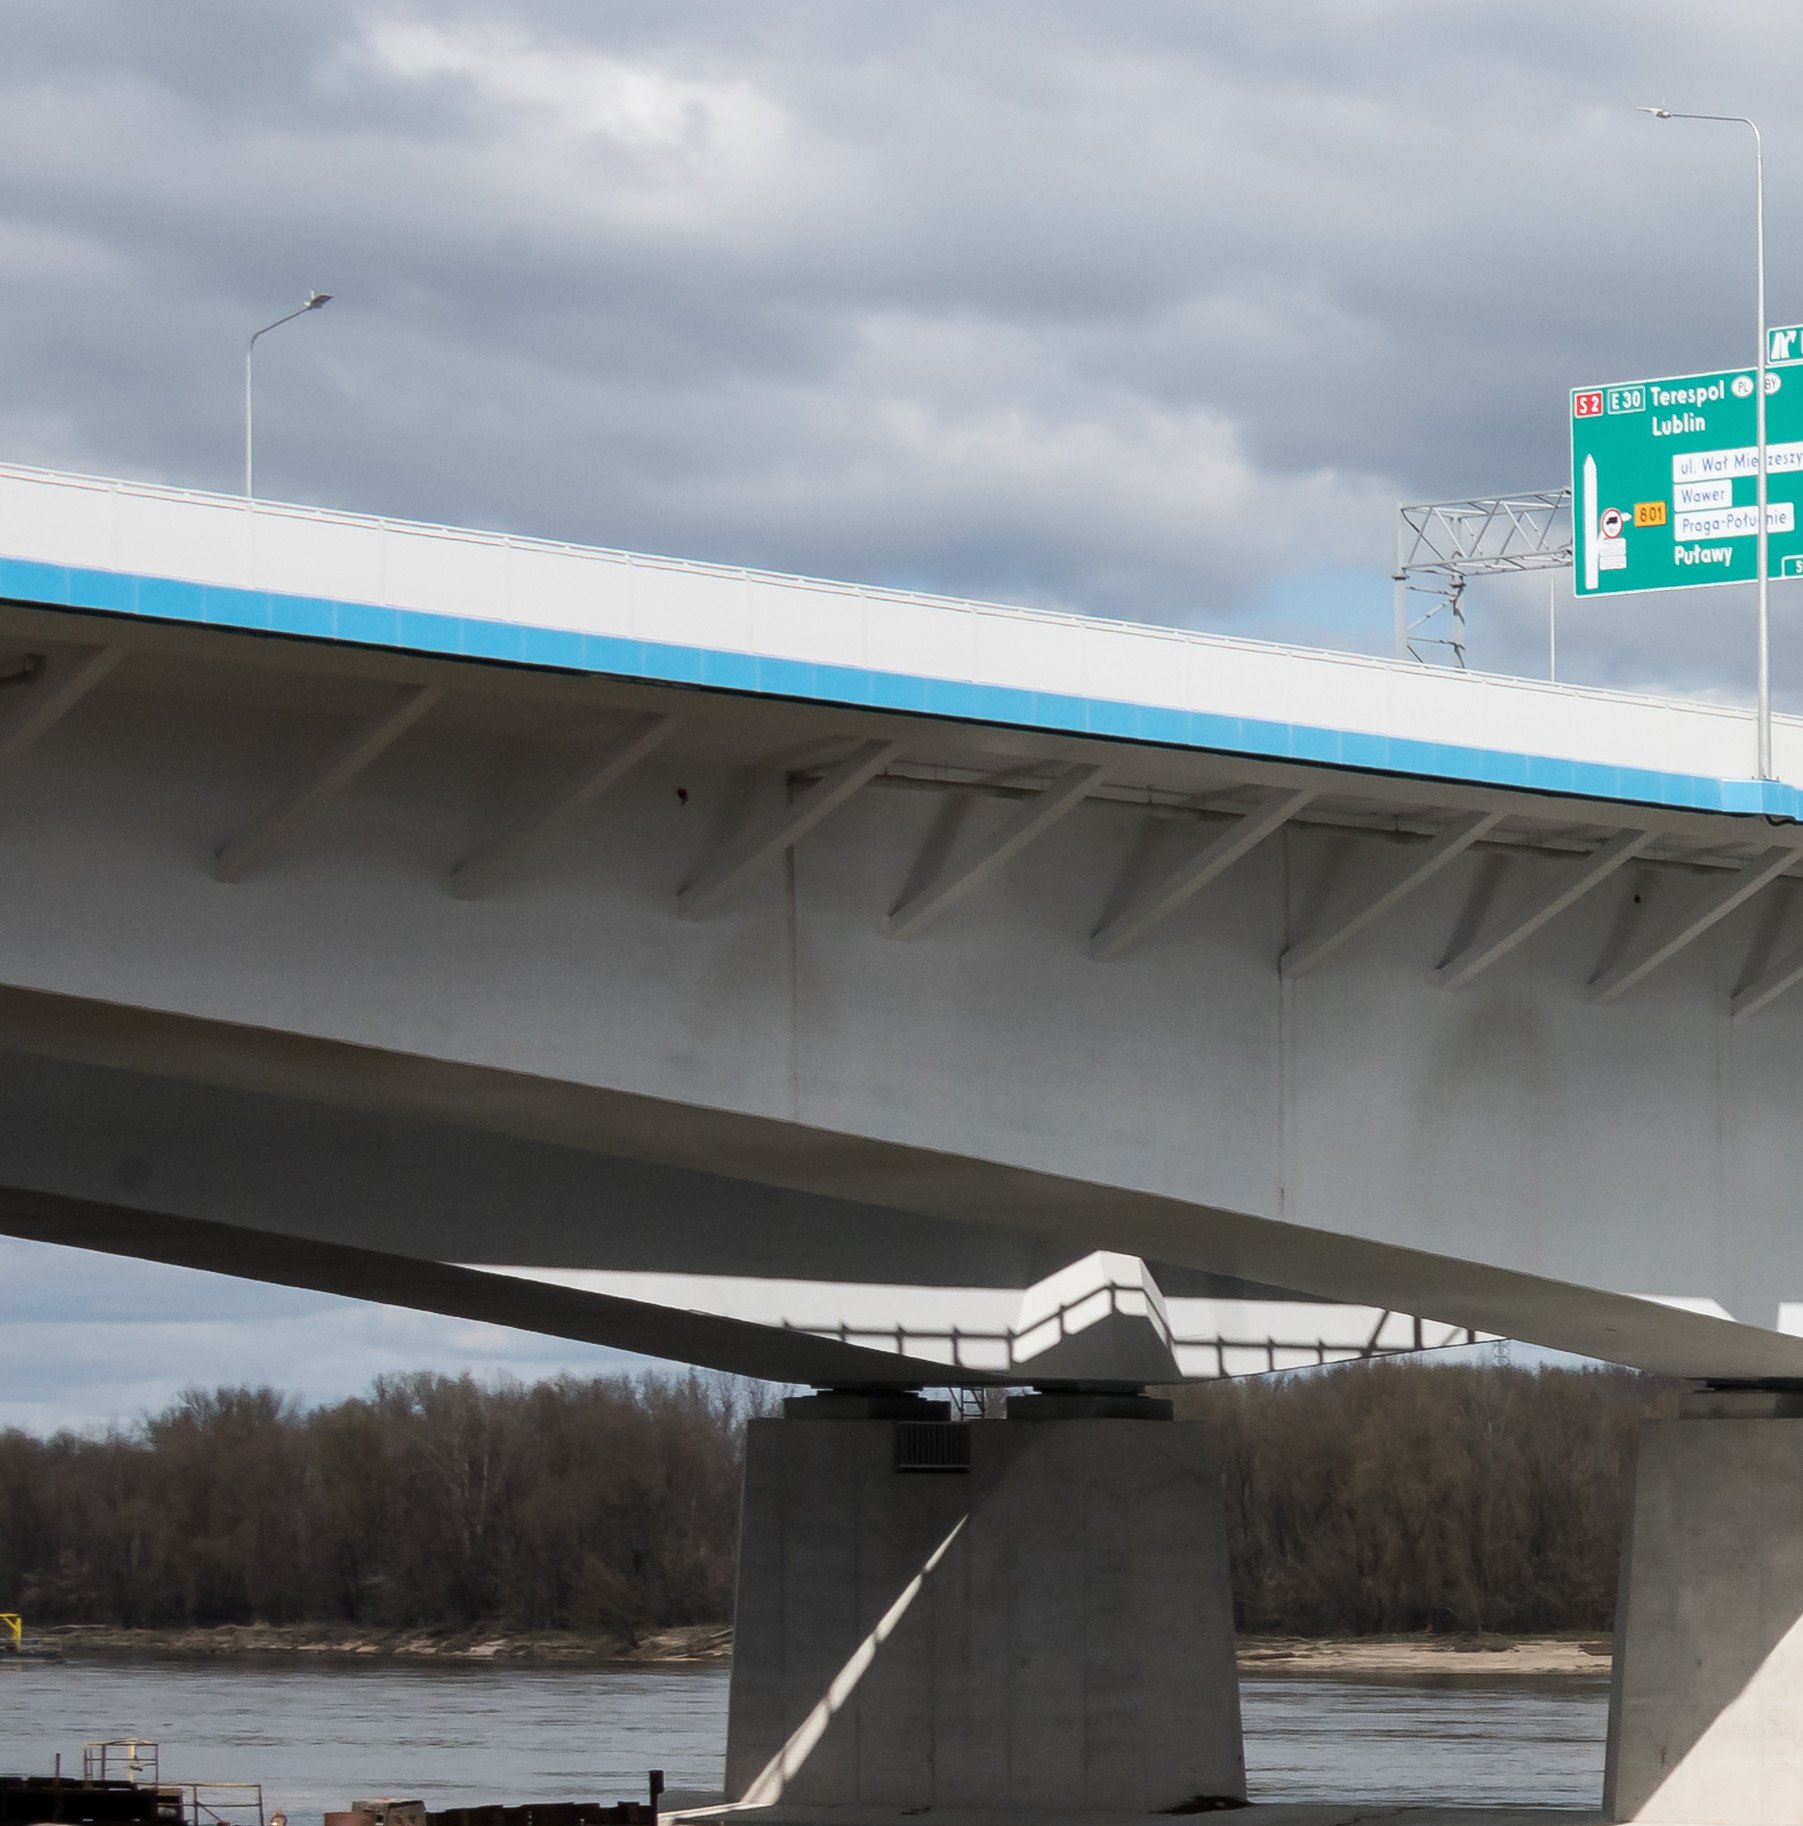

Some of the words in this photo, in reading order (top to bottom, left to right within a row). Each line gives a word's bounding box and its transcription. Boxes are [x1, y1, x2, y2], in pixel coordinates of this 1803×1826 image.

[1650, 379, 1725, 408] Terespol
[1738, 381, 1750, 393] PL
[1579, 397, 1588, 414] S
[1591, 396, 1600, 412] 2
[1612, 393, 1620, 410] E
[1622, 391, 1641, 409] 30
[1652, 412, 1706, 437] Lublin
[1681, 459, 1697, 475] ul.
[1702, 457, 1728, 472] Wał
[1681, 489, 1725, 504] Wawer
[1640, 506, 1662, 523] 801
[1682, 512, 1787, 536] Praga-Połunie
[1674, 544, 1733, 567] Puławy
